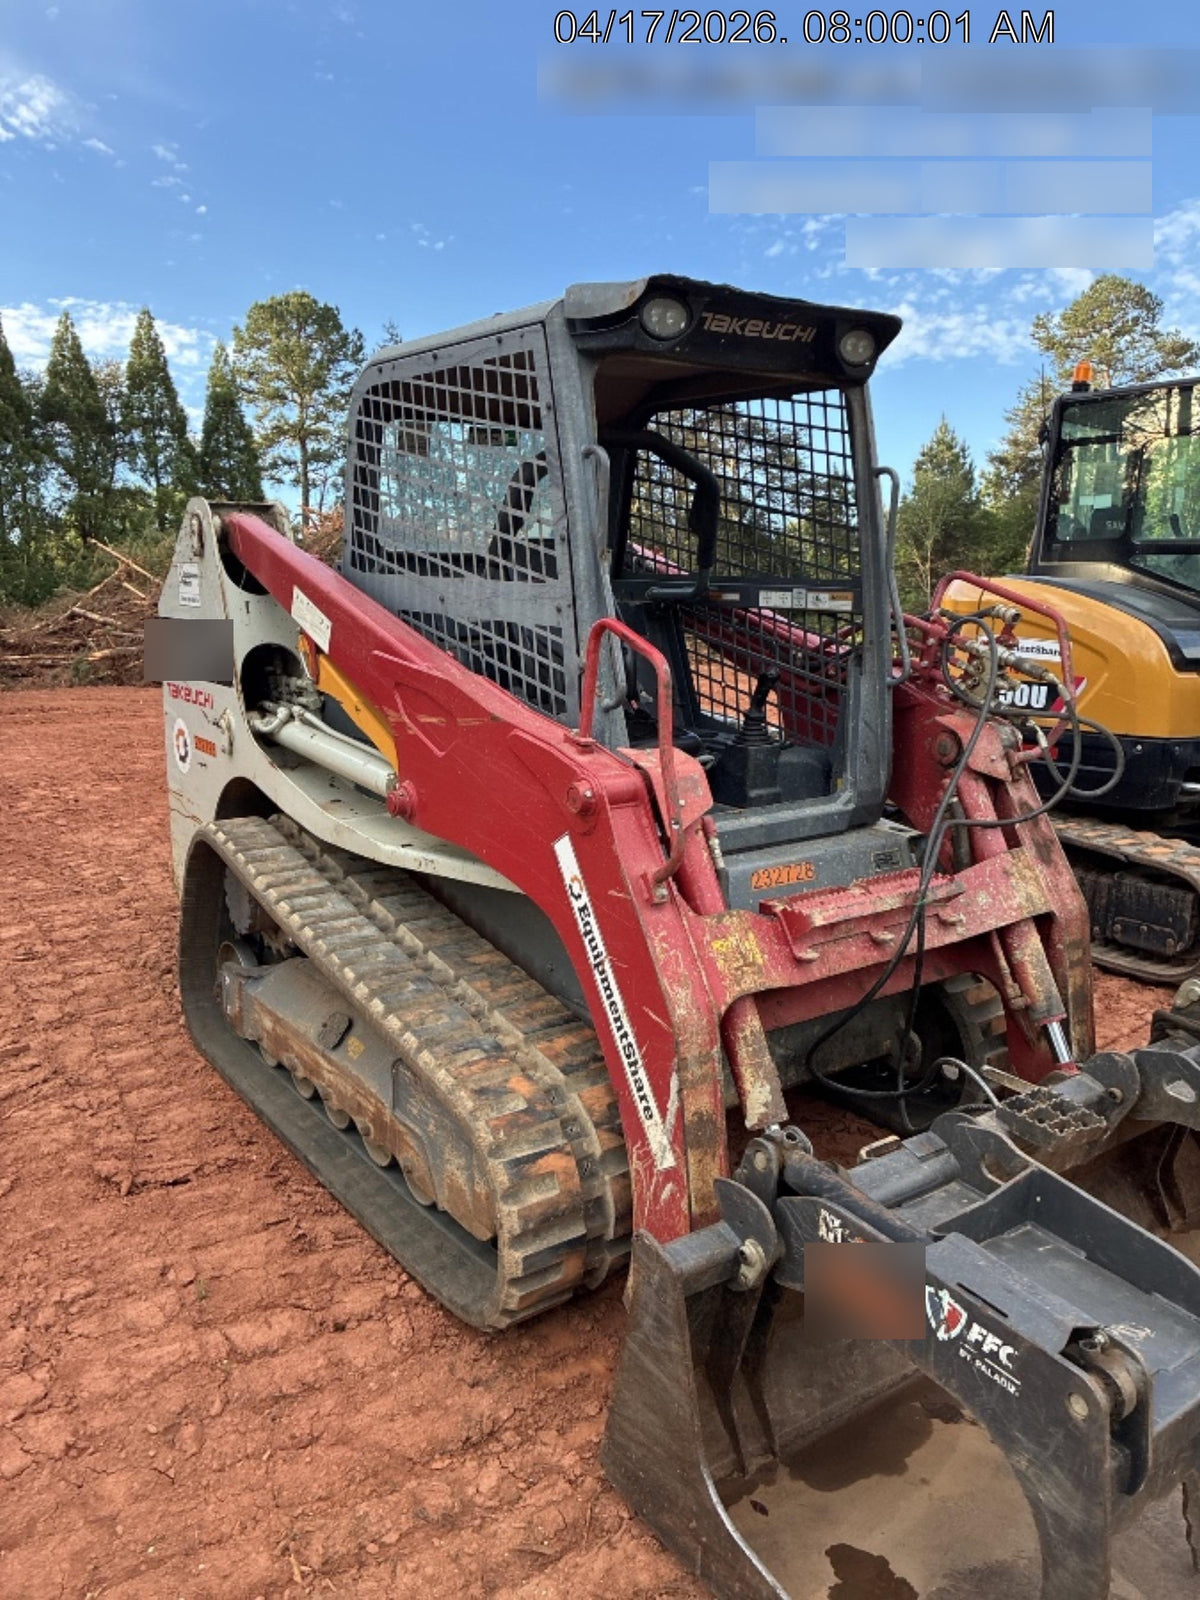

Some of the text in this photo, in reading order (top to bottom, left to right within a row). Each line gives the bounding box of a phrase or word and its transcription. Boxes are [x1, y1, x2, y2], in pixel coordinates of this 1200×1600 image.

[702, 311, 817, 342] TAKEUCHI
[166, 682, 214, 709] TAKEUCHI
[577, 902, 654, 1122] EquipmentShare
[967, 1322, 1015, 1370] FFC
